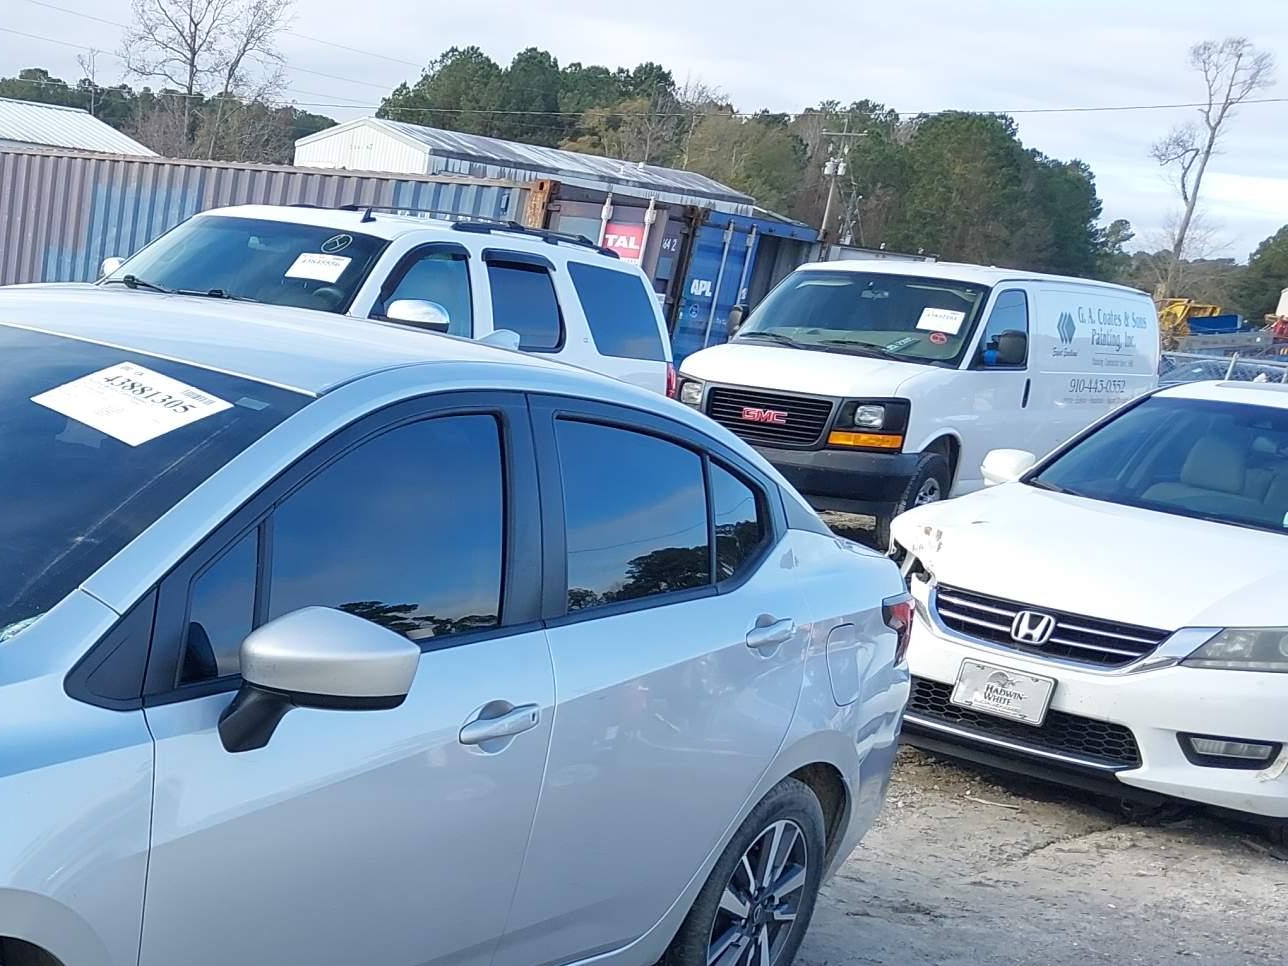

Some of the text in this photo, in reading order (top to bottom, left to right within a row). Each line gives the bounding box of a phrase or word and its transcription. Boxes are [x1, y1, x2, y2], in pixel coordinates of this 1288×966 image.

[605, 234, 640, 250] TAL
[690, 279, 713, 297] APL
[1097, 308, 1122, 327] Coates
[104, 375, 197, 413] 43881305
[743, 407, 788, 424] GMC
[983, 692, 1012, 706] WHITE
